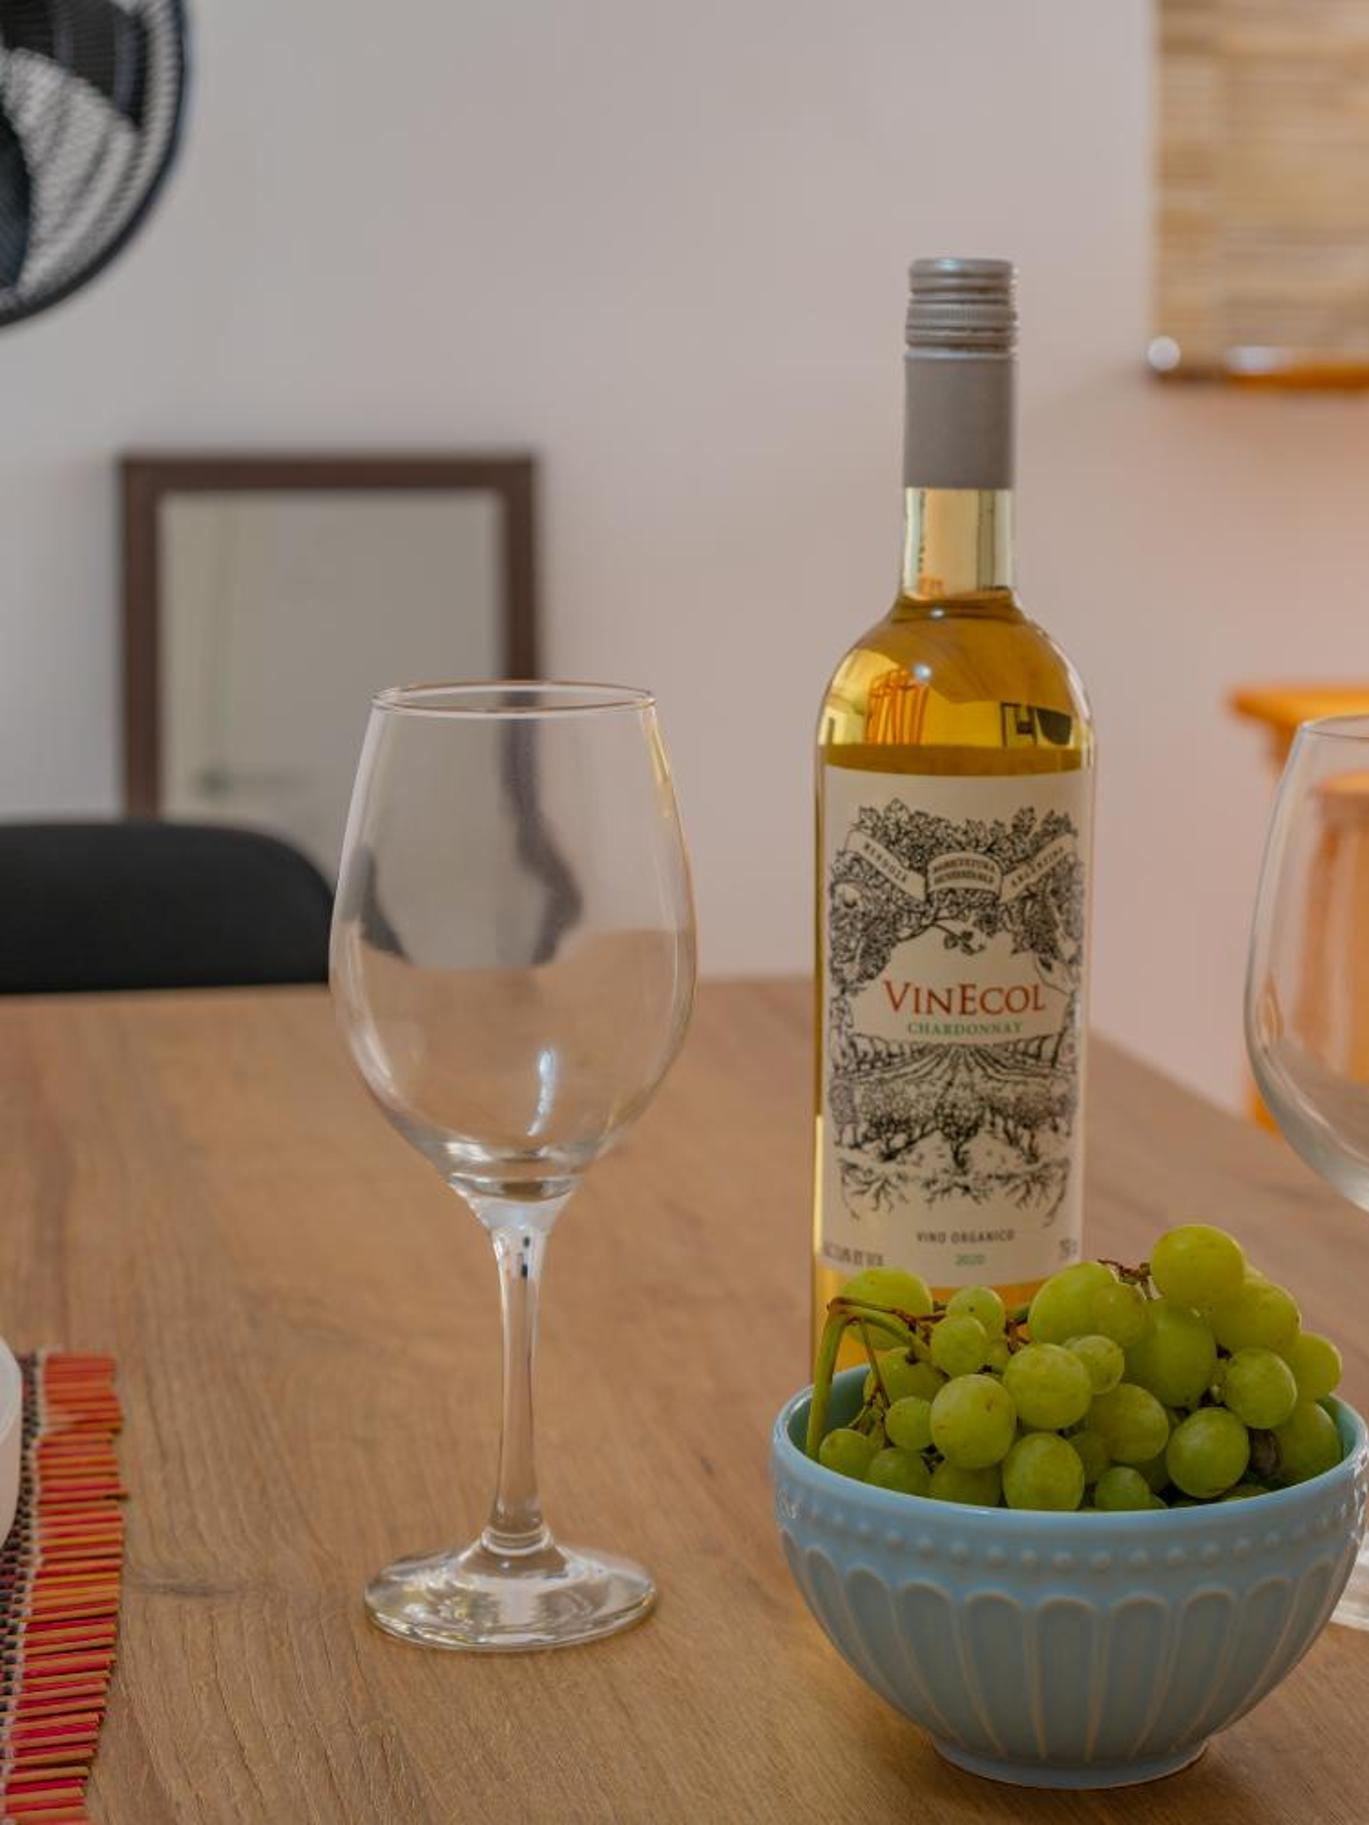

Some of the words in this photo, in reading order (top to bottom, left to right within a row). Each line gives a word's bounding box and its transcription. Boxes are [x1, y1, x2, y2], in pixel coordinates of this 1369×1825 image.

[908, 1021, 1024, 1035] CHARDONNAY
[917, 1230, 947, 1244] VINO
[951, 1229, 1016, 1244] ORGANICO
